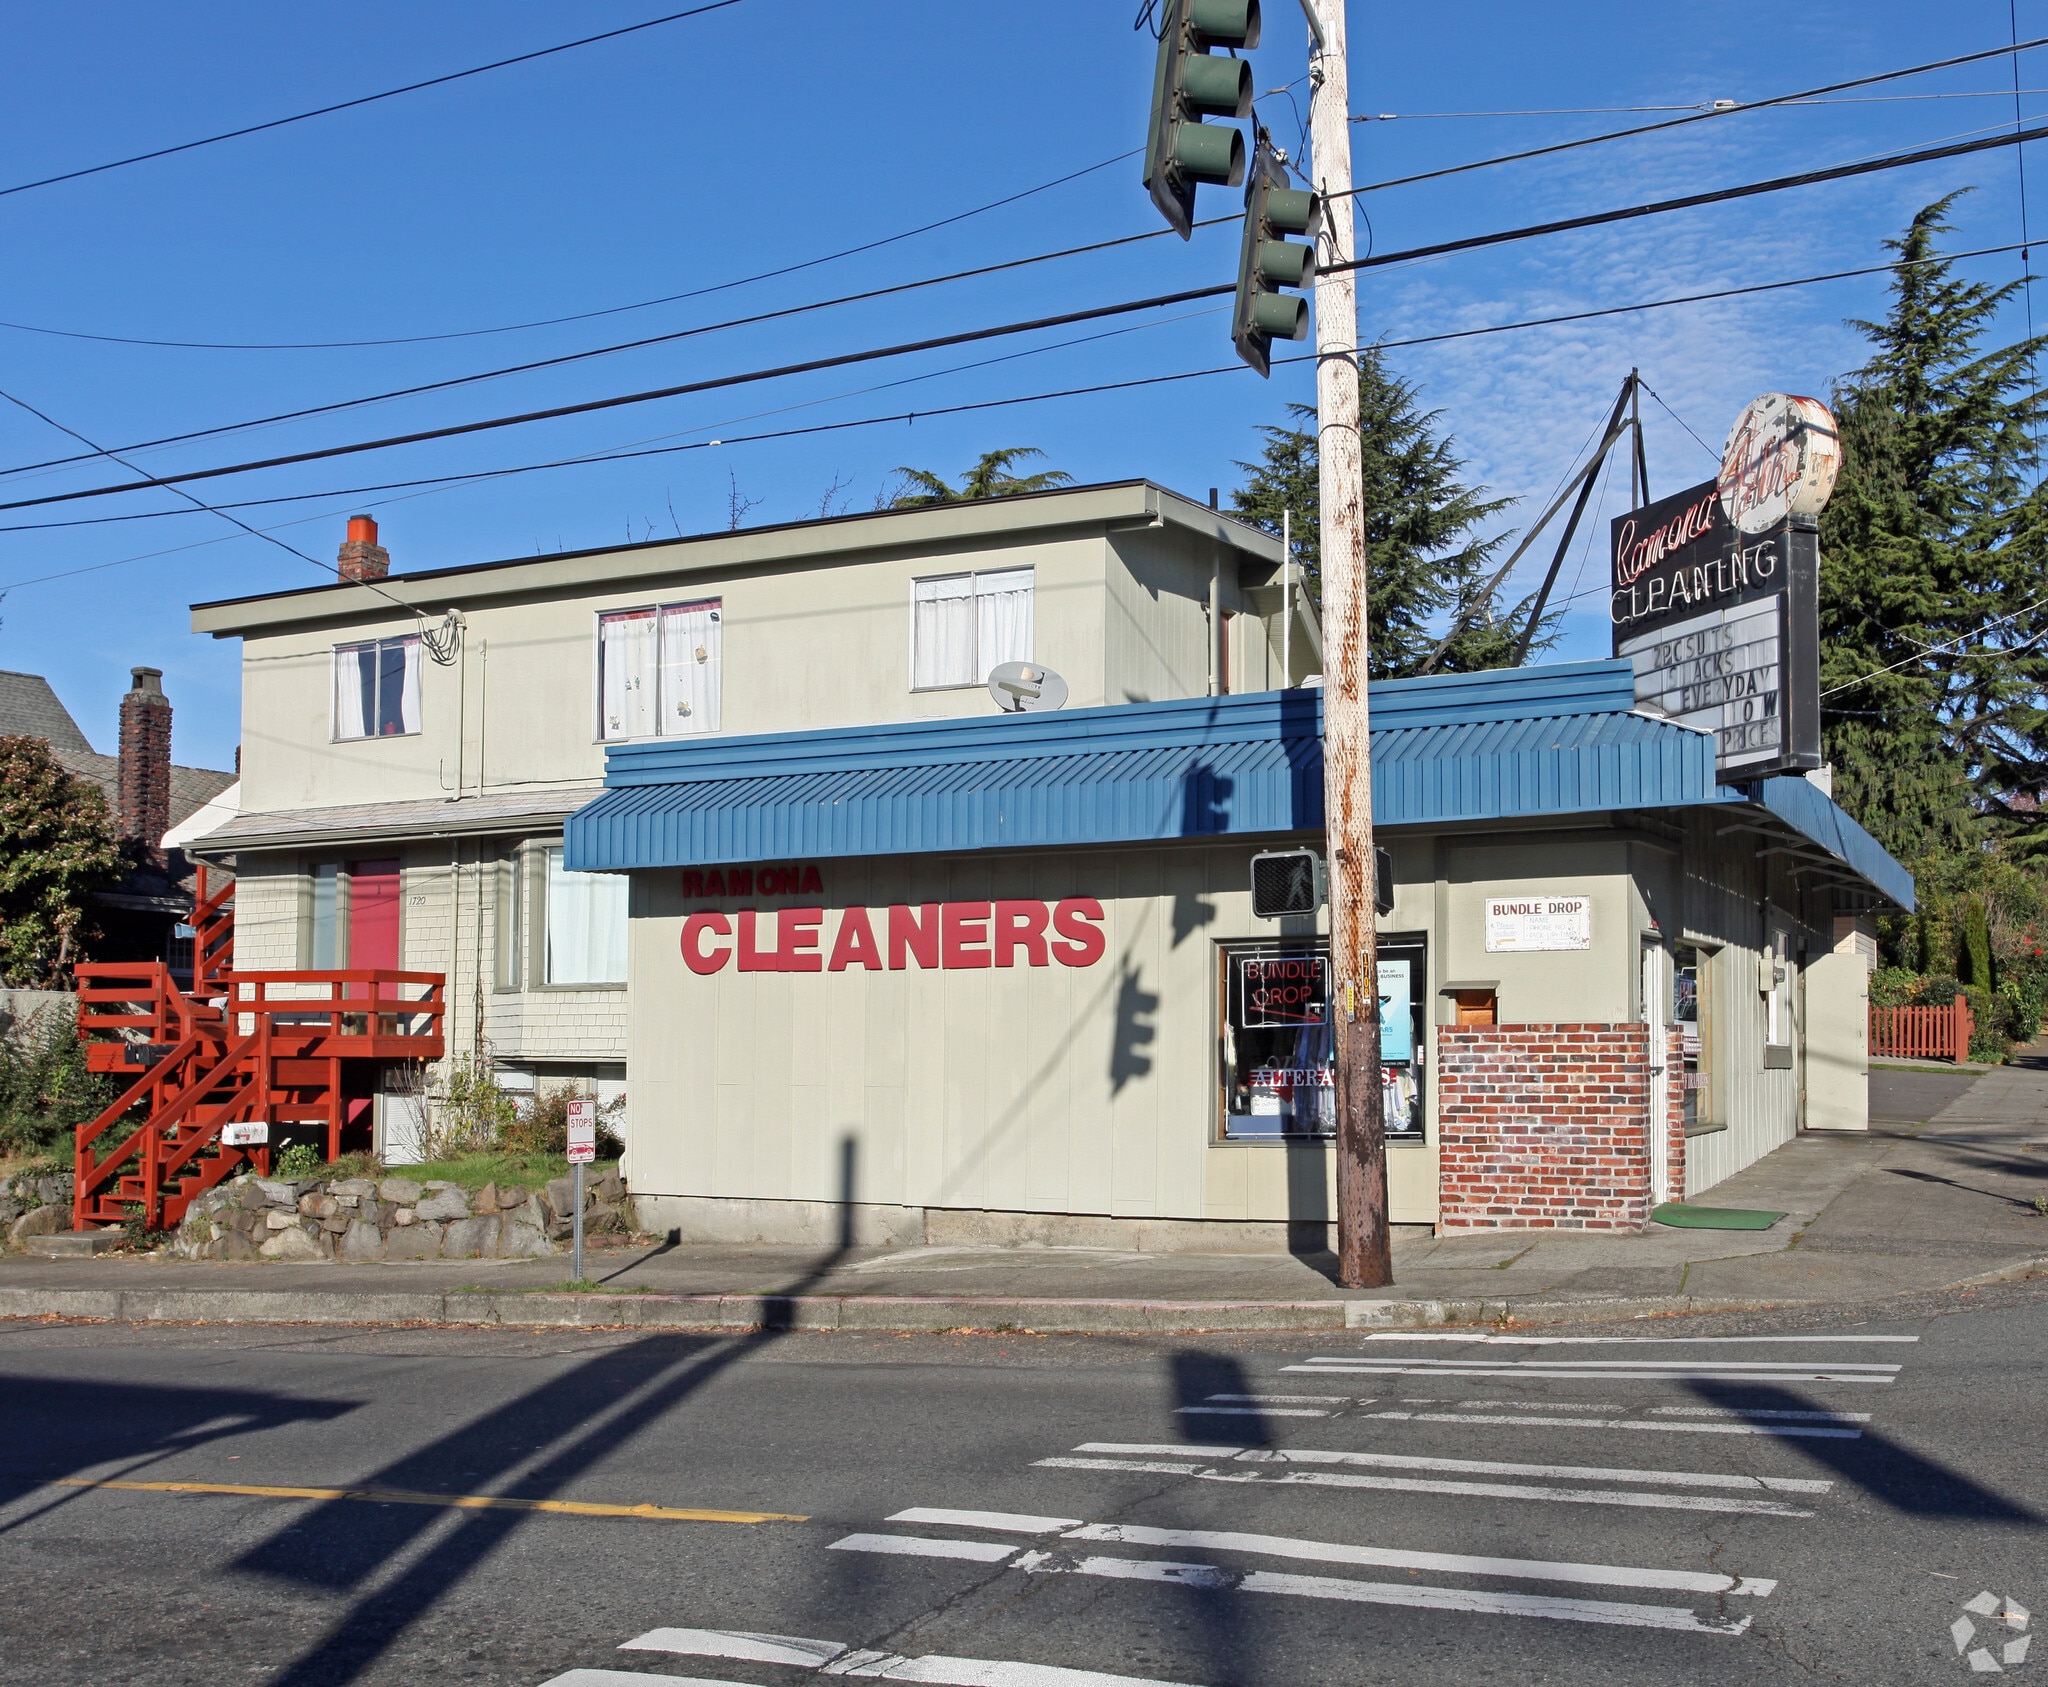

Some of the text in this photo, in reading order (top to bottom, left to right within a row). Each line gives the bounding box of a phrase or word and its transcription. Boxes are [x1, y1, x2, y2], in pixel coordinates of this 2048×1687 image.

[1617, 492, 1719, 586] Ramona
[1610, 540, 1778, 625] CLEANING
[1686, 625, 1734, 660] SUTS
[1724, 720, 1778, 749] PRICES
[682, 866, 824, 898] RAMONA
[409, 896, 427, 906] 1720
[1493, 902, 1582, 916] BUNDLE DROP
[681, 896, 1106, 975] CLEANERS
[1247, 961, 1322, 980] BUNDLE
[1254, 985, 1313, 1007] DROP
[570, 1103, 581, 1114] NO
[570, 1117, 593, 1129] STOPS
